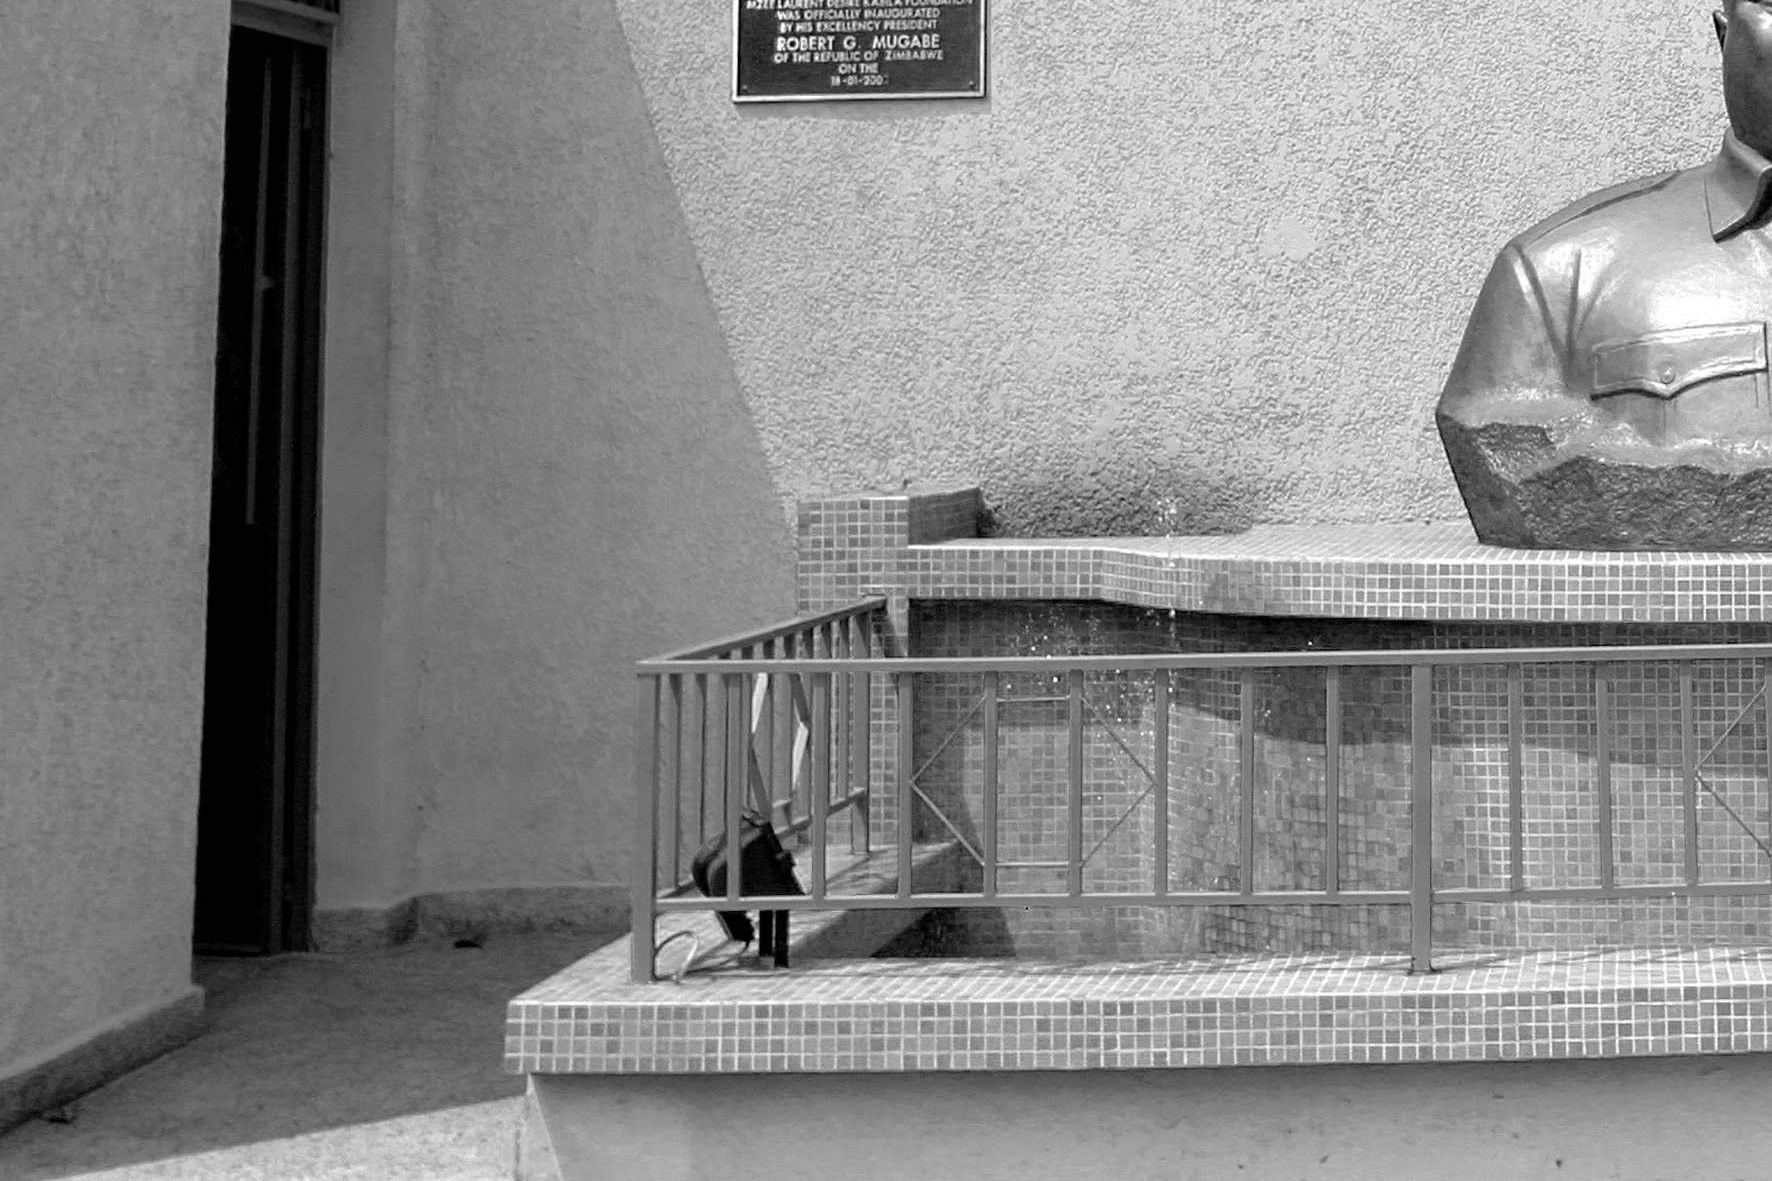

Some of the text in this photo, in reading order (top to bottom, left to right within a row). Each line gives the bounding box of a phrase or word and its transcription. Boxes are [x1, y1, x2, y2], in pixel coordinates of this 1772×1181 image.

[777, 8, 940, 20] WAS OFFICIALLY INAUGURATED
[780, 20, 938, 33] BY HIS EXCELLENCY PRESIDENT
[777, 34, 940, 51] ROBERT G. MUGABE
[774, 49, 943, 64] OF THE REPUBLIC OF ZIMBABWE
[839, 63, 878, 73] ON THE
